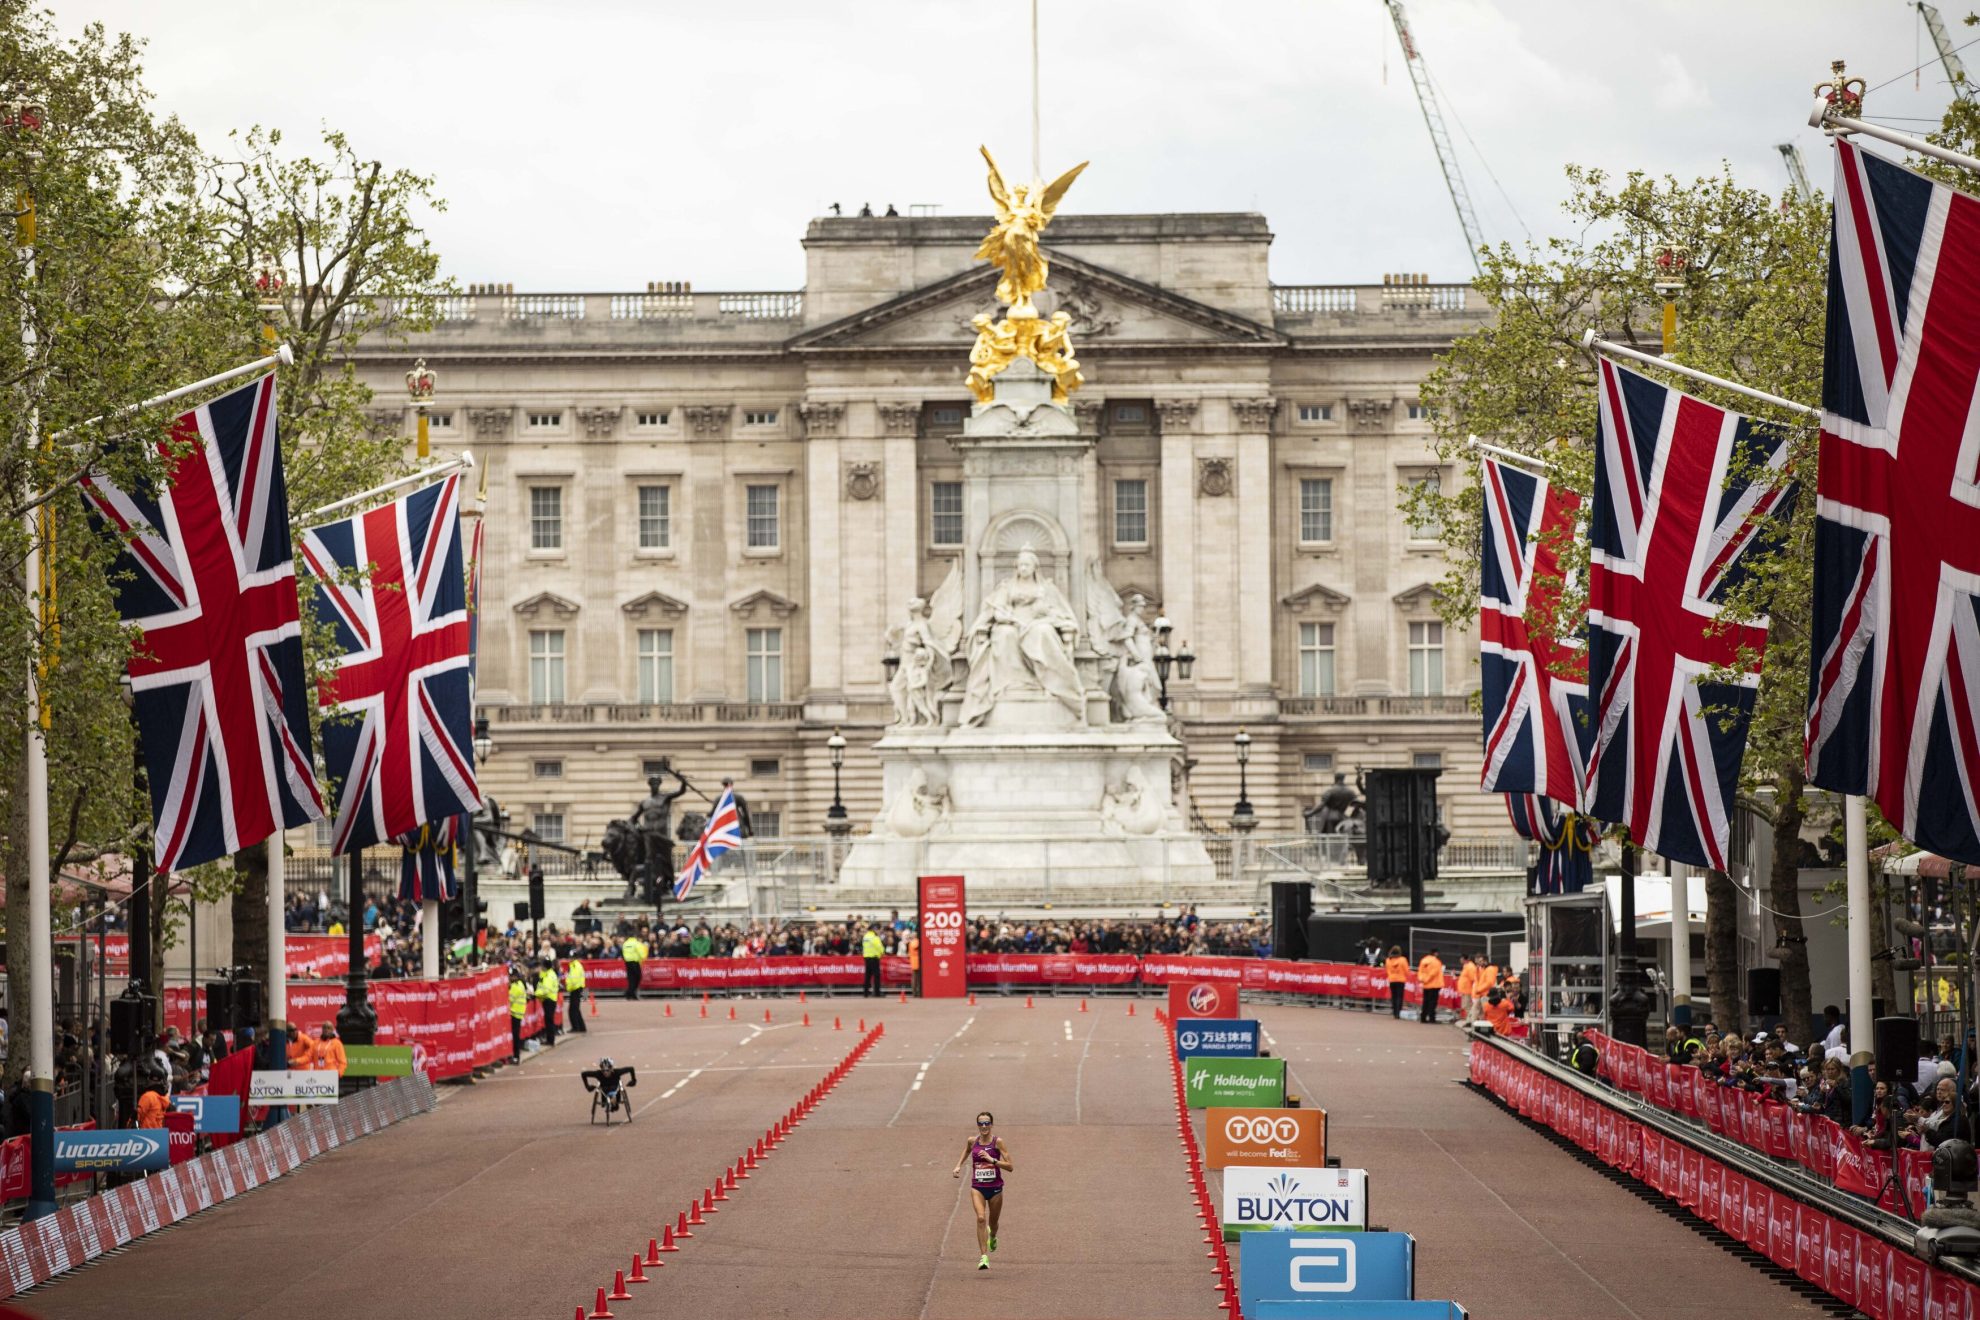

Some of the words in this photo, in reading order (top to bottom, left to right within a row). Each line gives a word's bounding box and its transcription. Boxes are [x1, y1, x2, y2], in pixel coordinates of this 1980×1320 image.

[924, 911, 962, 928] 200
[926, 929, 960, 937] METRES
[929, 937, 942, 945] TO
[943, 937, 958, 945] GO
[728, 965, 759, 977] London
[1144, 964, 1166, 976] Virgin
[290, 994, 307, 1010] virgin
[308, 996, 328, 1008] money
[328, 993, 347, 1005] londo
[1190, 988, 1216, 1011] Virgin
[1202, 1032, 1252, 1042] 万达体育
[1214, 1074, 1257, 1089] Holiday
[1258, 1075, 1276, 1086] Inn
[249, 1087, 283, 1096] UXTON
[296, 1086, 335, 1095] BUXTON
[56, 1139, 144, 1158] Lucozade
[75, 1159, 122, 1168] SPORT
[1237, 1198, 1349, 1222] BUXTON
